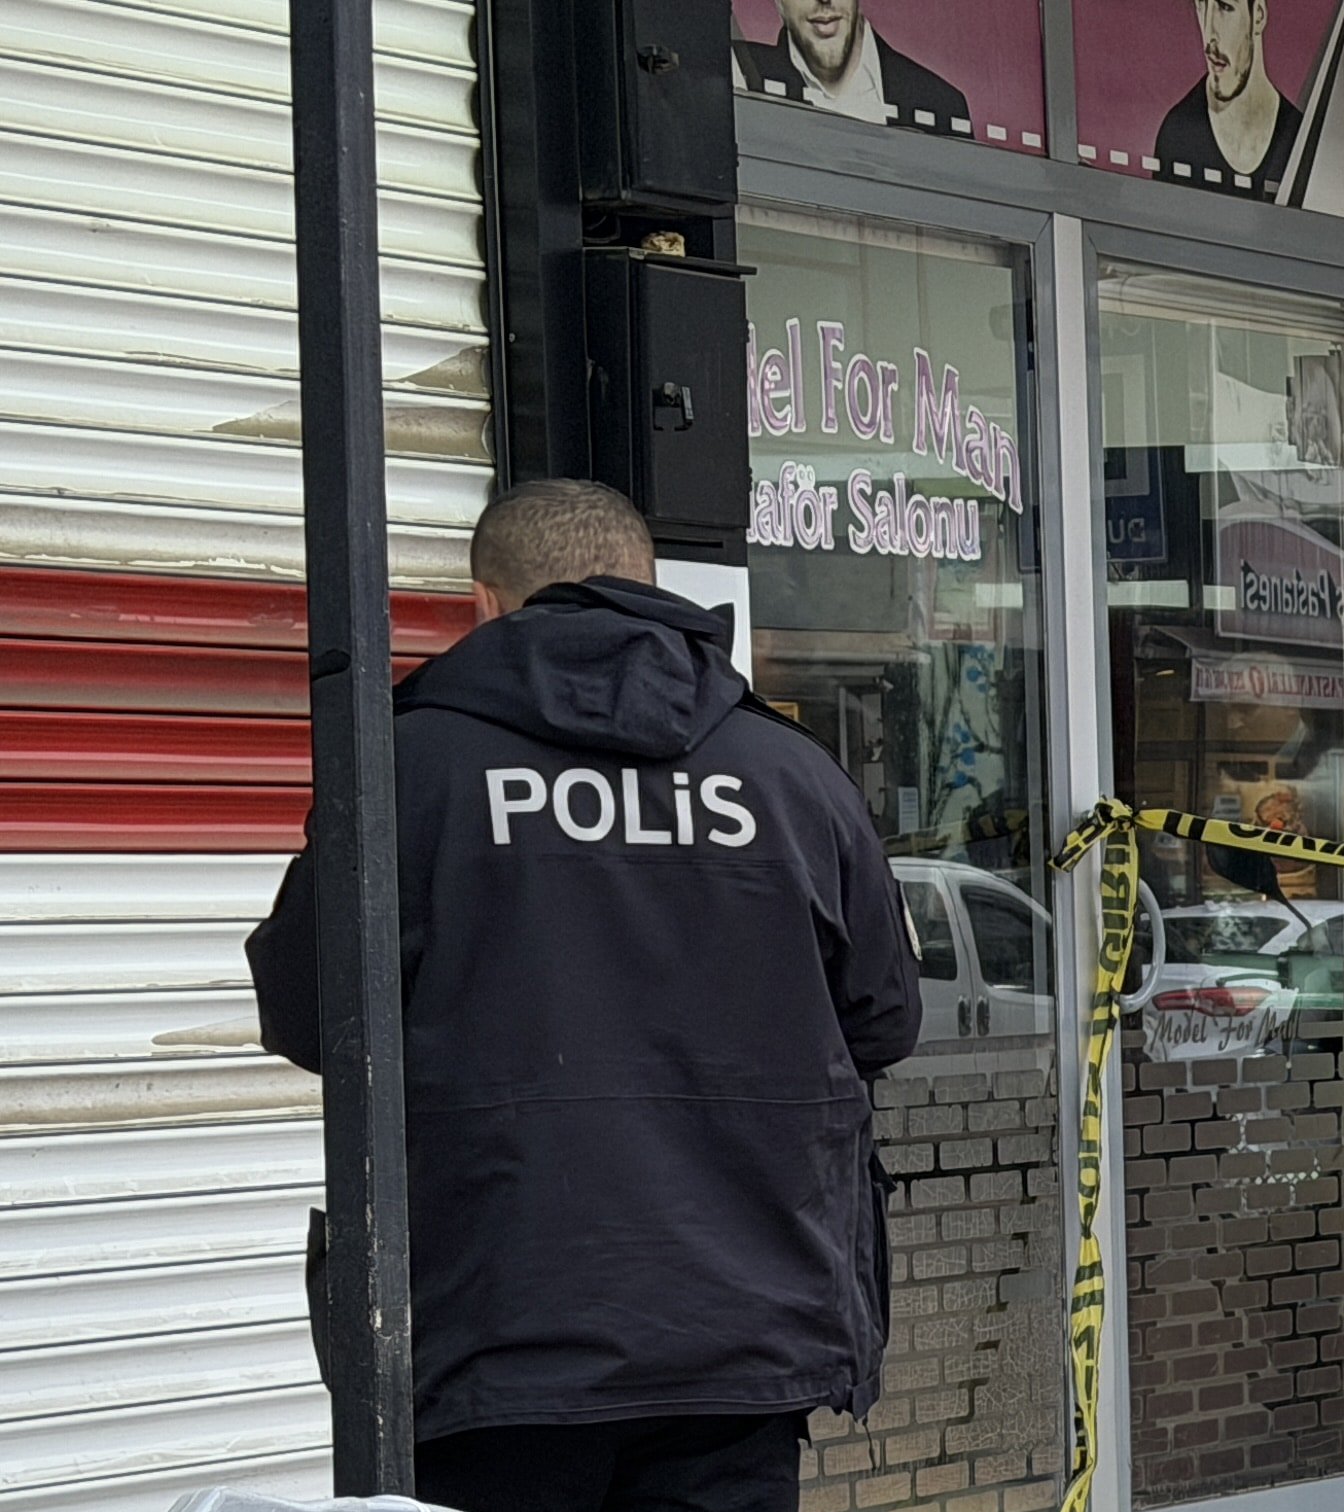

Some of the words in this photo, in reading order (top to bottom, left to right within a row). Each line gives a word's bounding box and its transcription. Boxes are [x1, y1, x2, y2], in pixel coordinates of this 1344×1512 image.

[817, 320, 899, 444] For
[913, 347, 1023, 515] Man
[848, 468, 981, 561] Salonu
